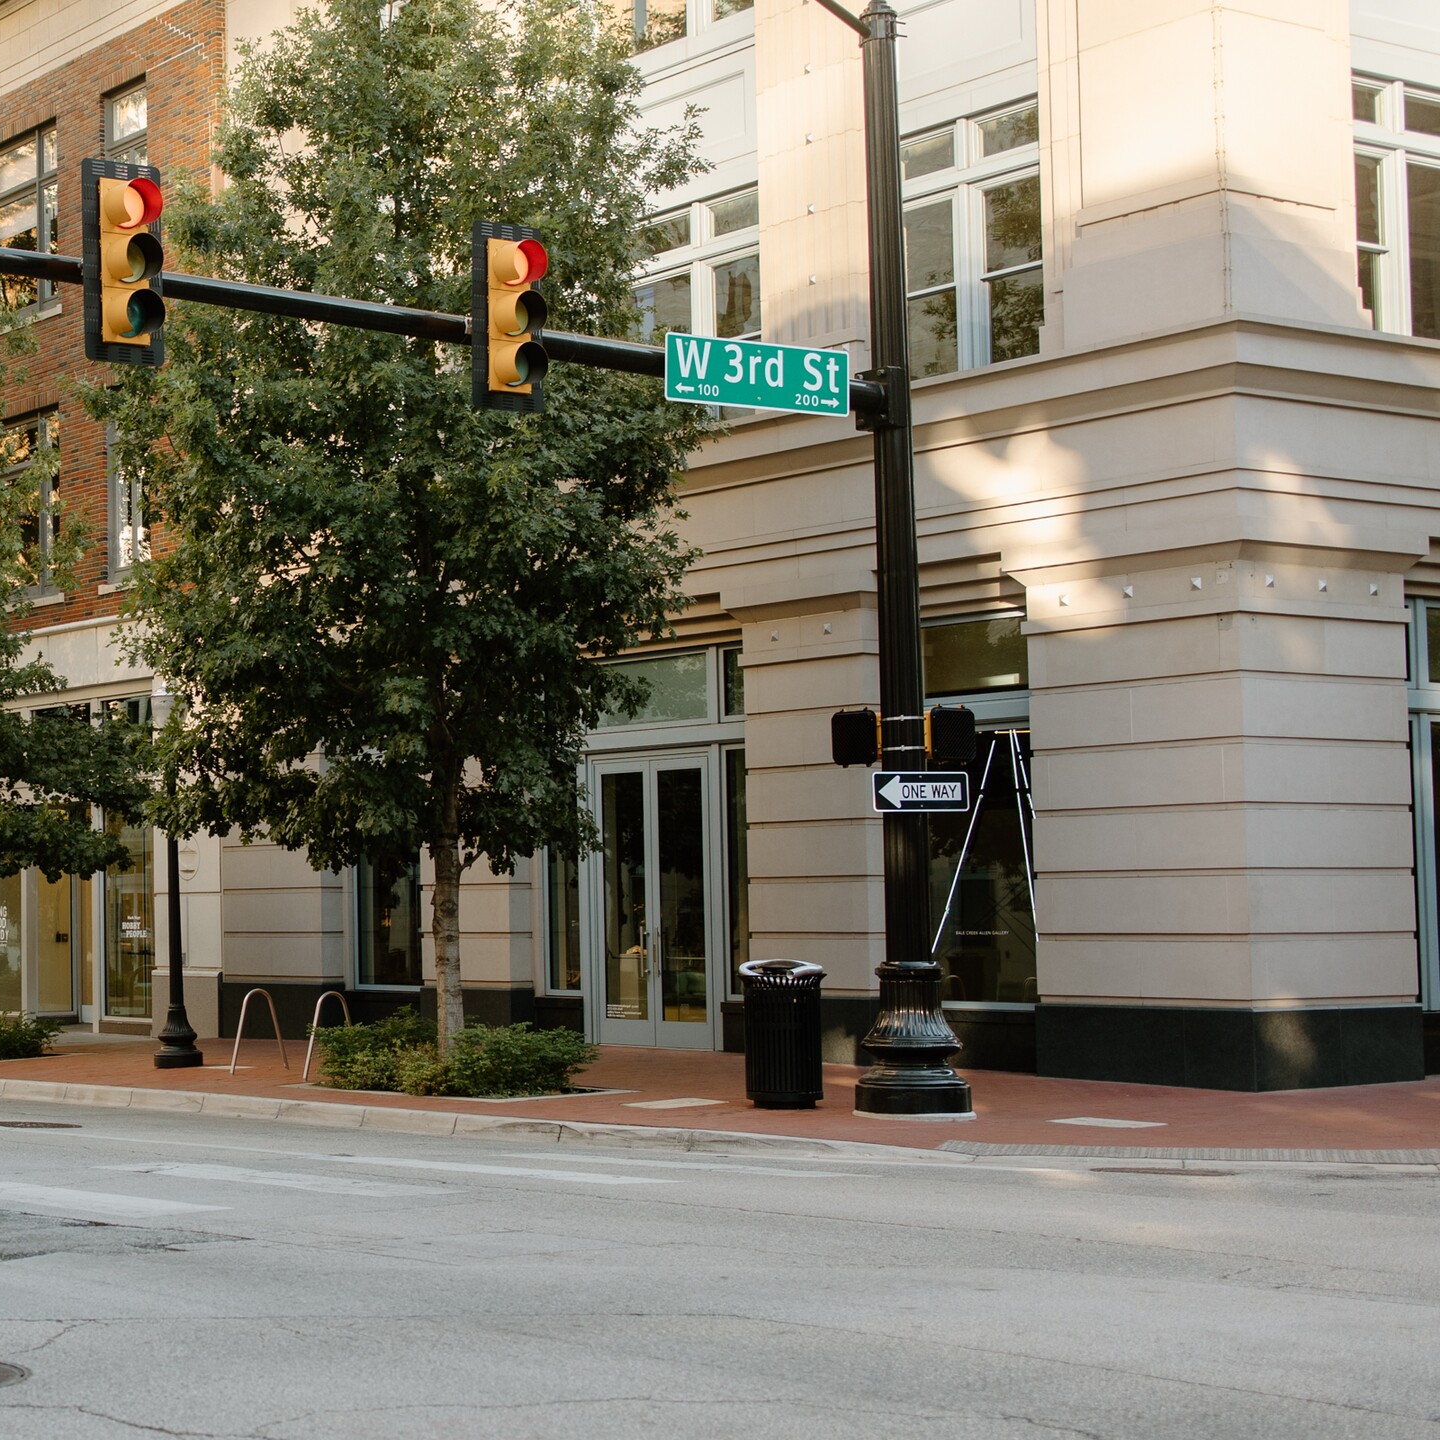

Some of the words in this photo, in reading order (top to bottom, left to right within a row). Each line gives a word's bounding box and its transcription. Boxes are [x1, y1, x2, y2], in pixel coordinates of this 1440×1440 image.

[675, 338, 712, 379] W
[723, 343, 784, 388] 3rd
[803, 352, 840, 393] St
[697, 384, 719, 397] 100
[795, 393, 819, 406] 200
[902, 785, 927, 799] ONE
[931, 785, 957, 798] WAY
[121, 921, 141, 930] HOBBY
[126, 930, 147, 938] PEOPLE
